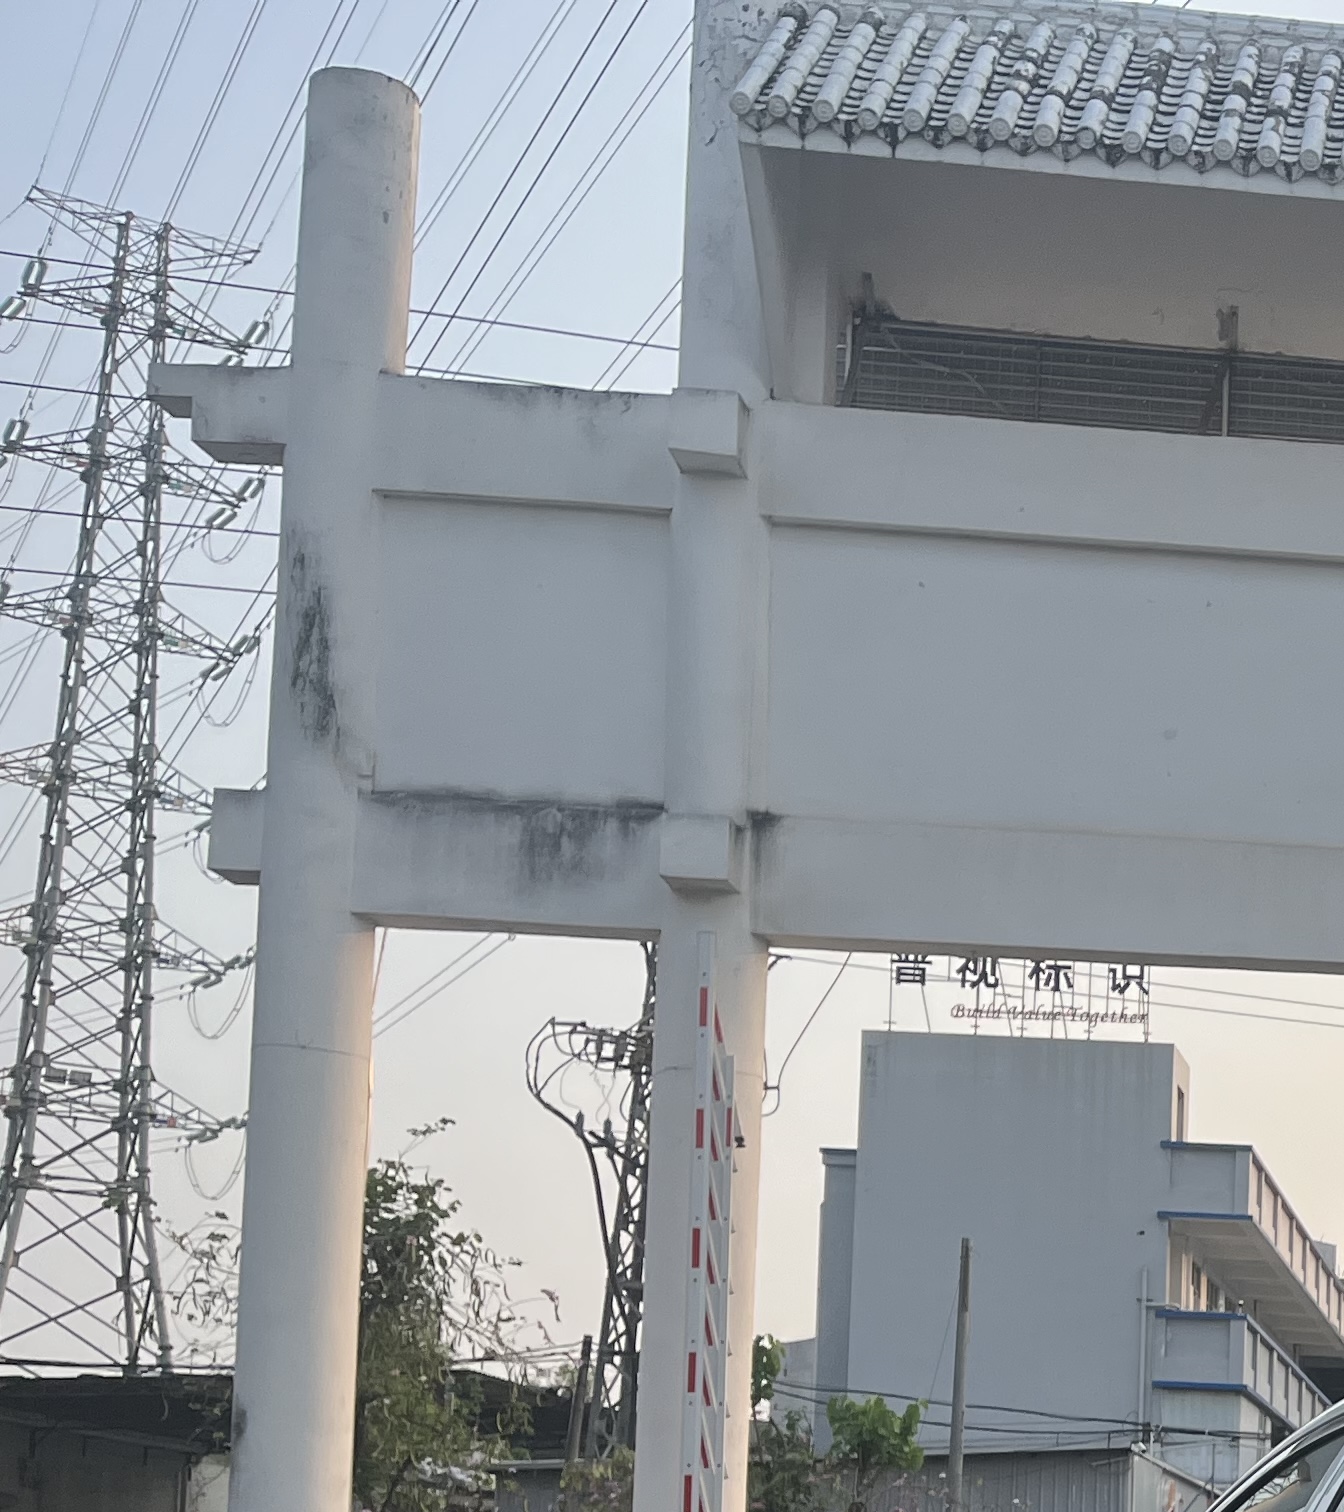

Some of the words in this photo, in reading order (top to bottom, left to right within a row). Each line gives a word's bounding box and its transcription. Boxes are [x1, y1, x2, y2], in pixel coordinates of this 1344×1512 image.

[951, 1003, 1001, 1019] Build
[1007, 1004, 1061, 1021] Value
[1066, 1006, 1148, 1028] Together
